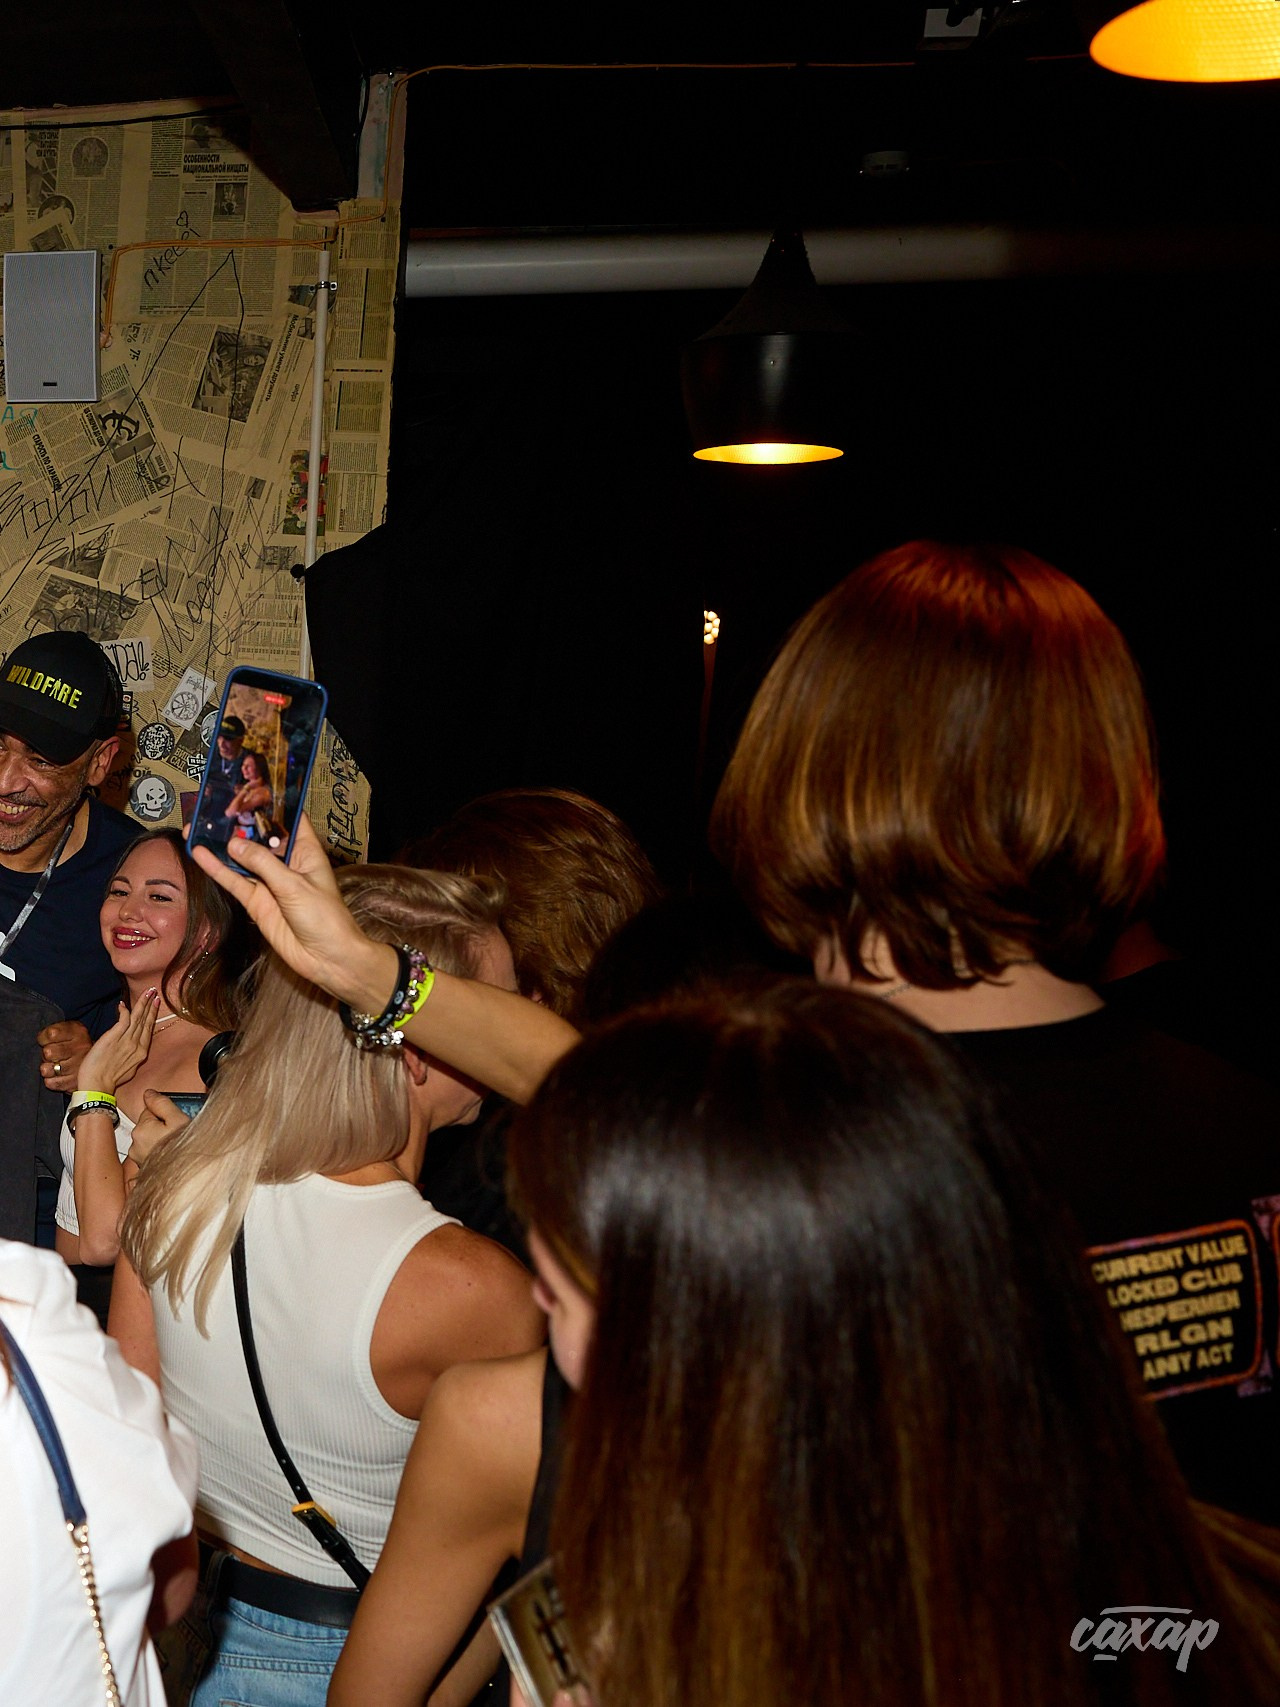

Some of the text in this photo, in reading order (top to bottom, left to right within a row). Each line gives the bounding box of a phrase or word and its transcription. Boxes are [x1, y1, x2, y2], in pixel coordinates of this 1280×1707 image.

[1090, 1233, 1248, 1285] CURRENT VALUE
[1105, 1261, 1244, 1309] LOCKED CLUB
[1133, 1316, 1234, 1357] RLGN
[1142, 1341, 1235, 1383] ANY ACT
